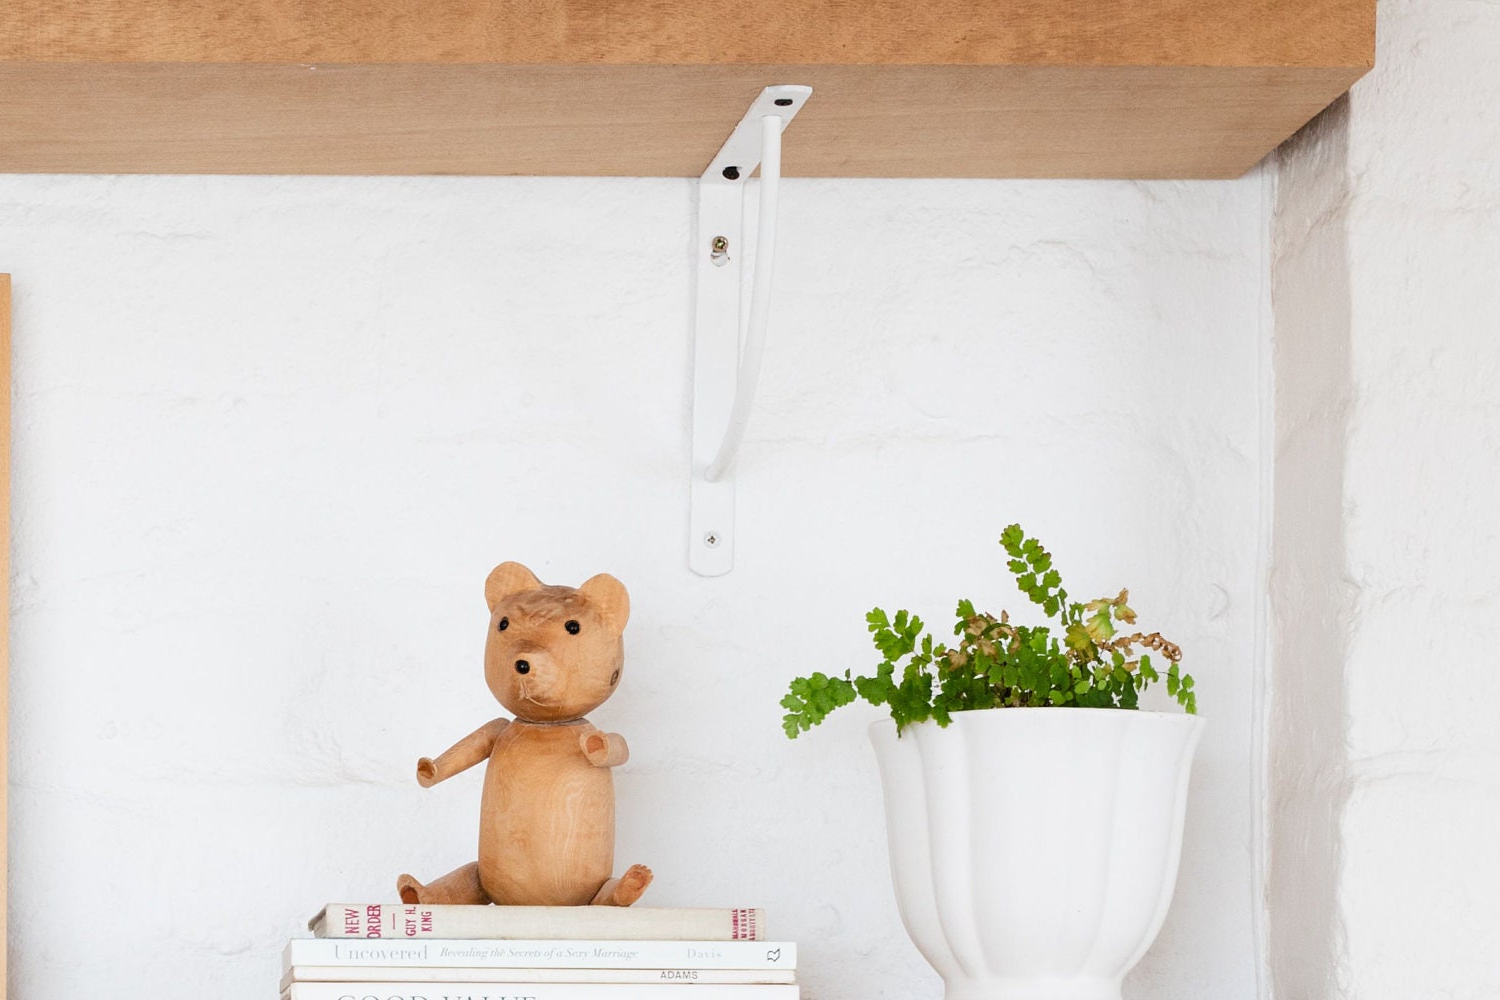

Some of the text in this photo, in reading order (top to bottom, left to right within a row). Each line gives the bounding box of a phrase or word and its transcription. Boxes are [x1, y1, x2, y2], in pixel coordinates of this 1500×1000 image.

[344, 908, 360, 935] NEW
[366, 903, 382, 939] ORDER
[404, 905, 417, 937] GUY H.
[420, 911, 433, 932] KING
[334, 944, 638, 962] Uncovered Revealing the Secrets of a Sexy Marriage
[686, 947, 722, 959] Davis
[659, 970, 698, 980] ADAMS
